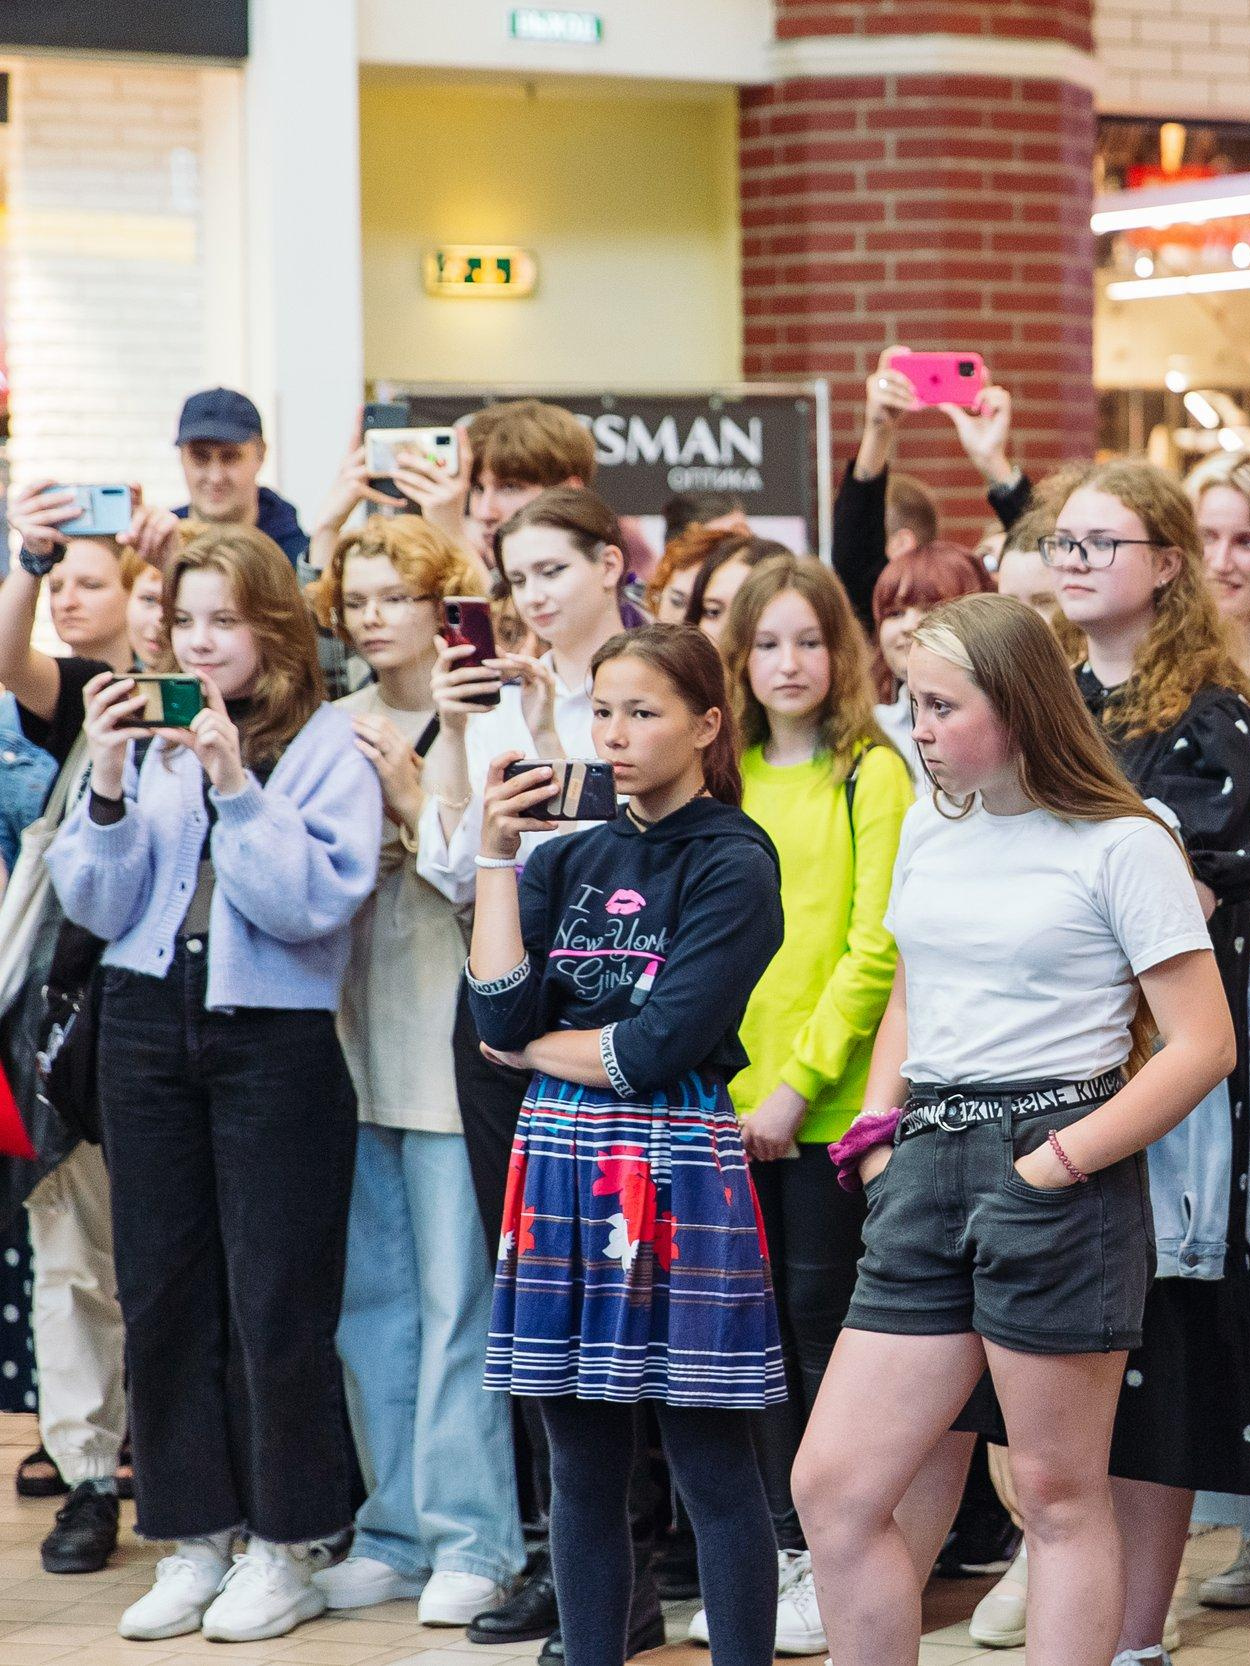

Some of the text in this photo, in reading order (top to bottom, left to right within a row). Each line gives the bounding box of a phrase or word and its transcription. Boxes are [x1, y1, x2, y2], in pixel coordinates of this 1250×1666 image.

[573, 413, 763, 466] SMAN
[569, 884, 604, 914] I
[553, 917, 670, 962] New York
[556, 957, 634, 1000] Girls
